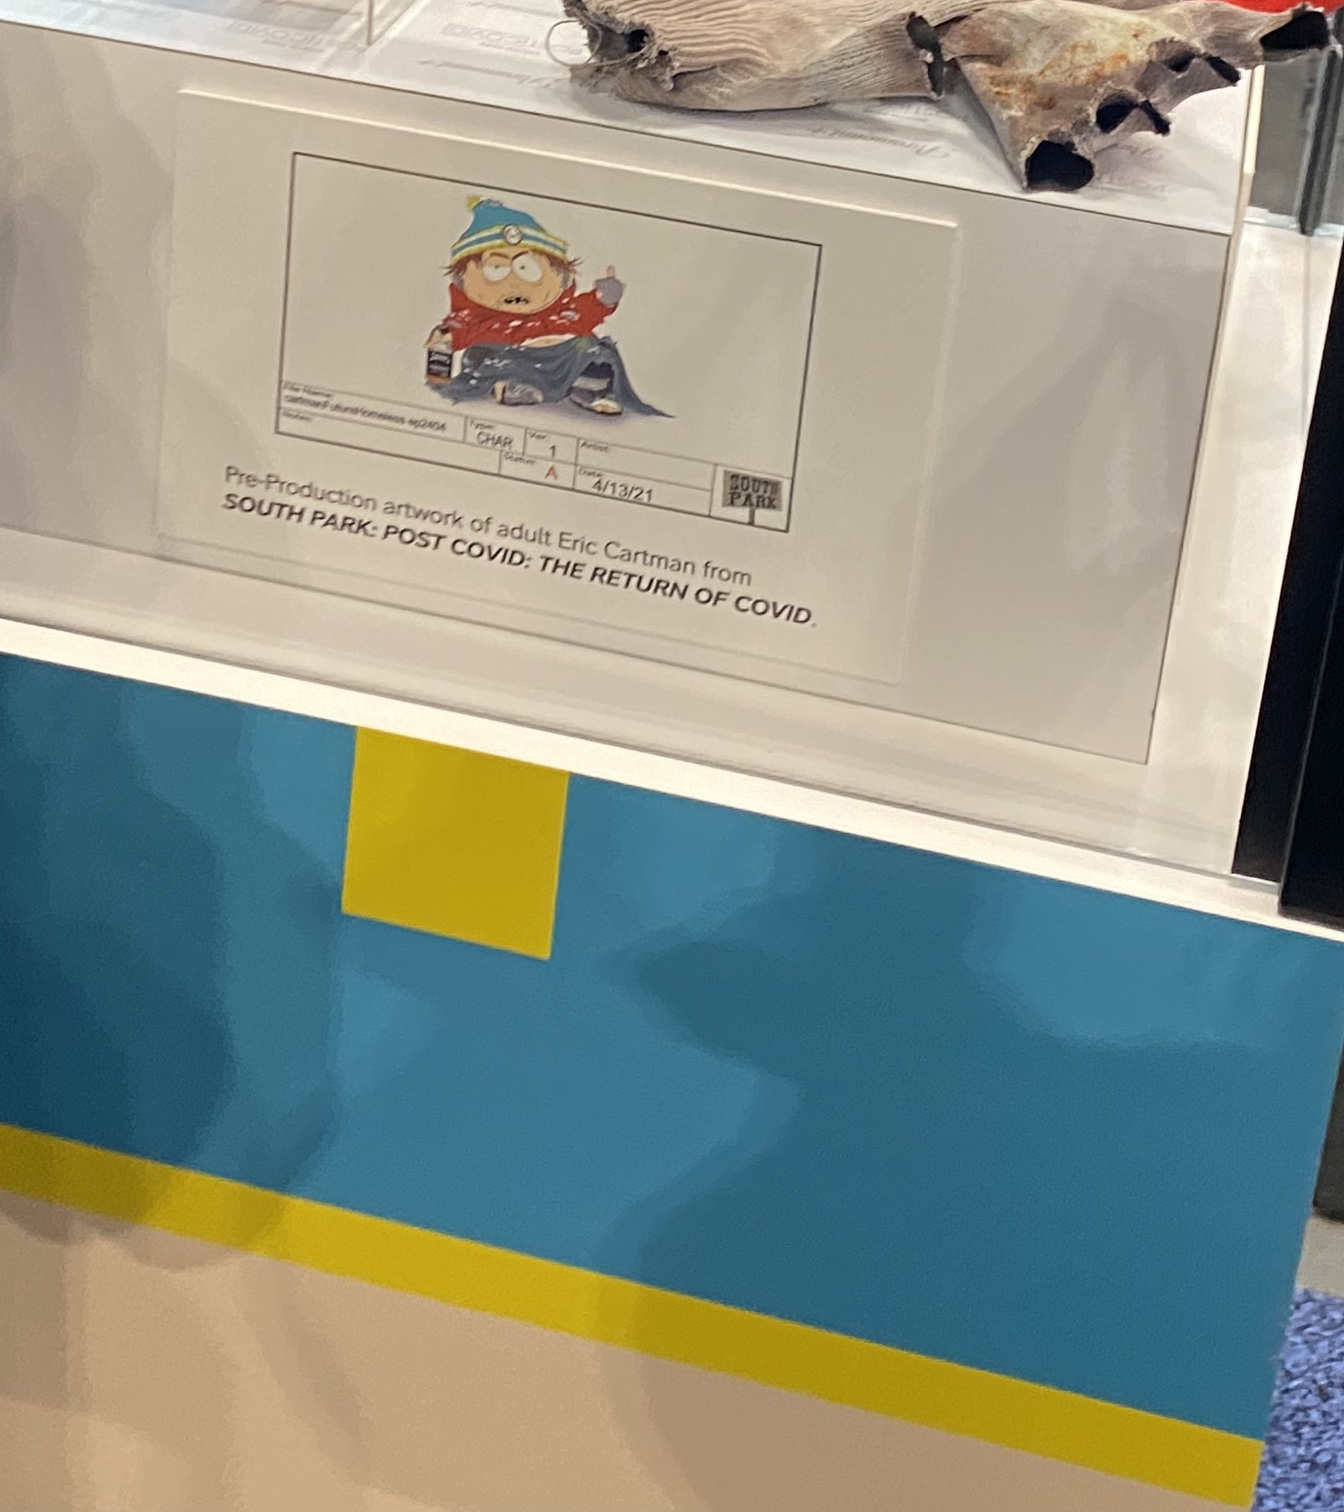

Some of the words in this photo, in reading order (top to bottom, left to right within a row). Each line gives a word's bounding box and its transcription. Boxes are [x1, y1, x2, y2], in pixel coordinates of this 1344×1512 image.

[544, 464, 559, 480] A
[592, 478, 654, 503] 4/13/21
[728, 491, 777, 509] PARK
[224, 464, 378, 512] Pre-Production
[382, 502, 464, 530] artwork
[470, 515, 495, 533] of
[497, 521, 553, 548] adult
[558, 530, 599, 556] Eric
[603, 539, 697, 577] Cartman
[702, 560, 754, 588] from
[221, 491, 307, 524] SOUTH
[308, 509, 380, 539] PARK:
[381, 523, 448, 551] POST
[450, 537, 533, 570] COVID:
[539, 554, 587, 581] THE
[589, 565, 691, 602] RETURN
[694, 586, 731, 608] OF
[733, 594, 819, 628] COVID.
